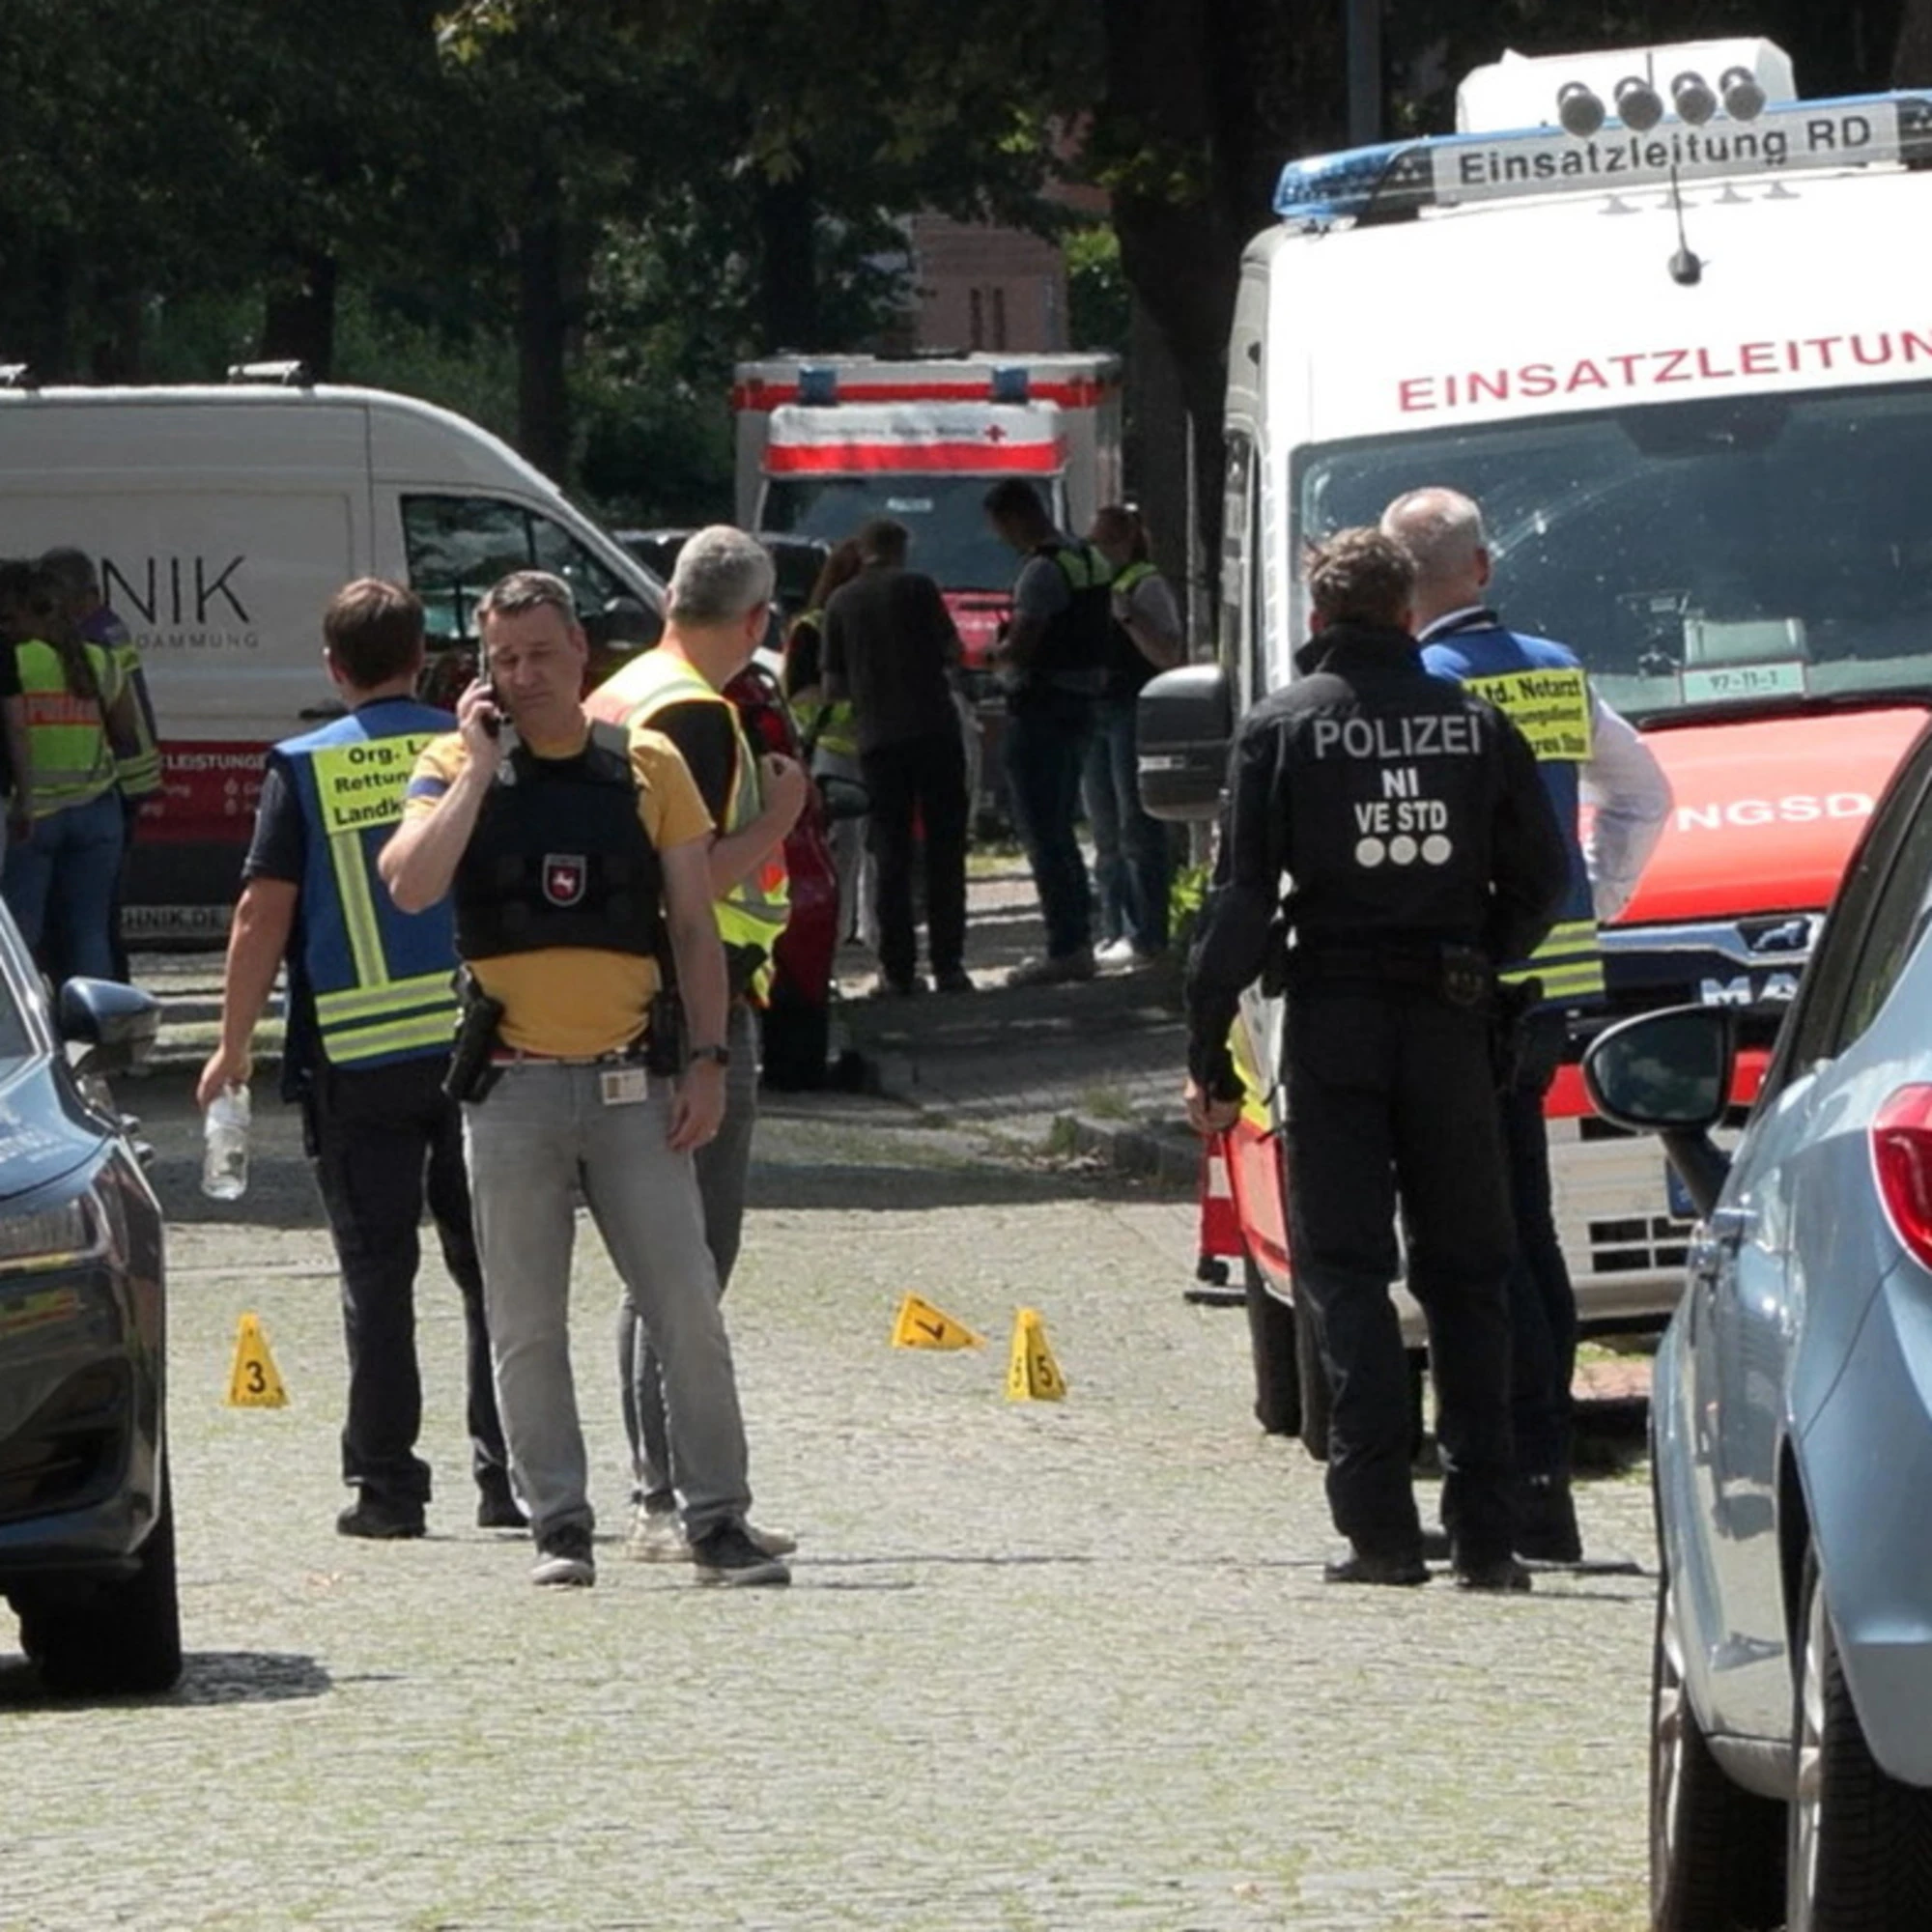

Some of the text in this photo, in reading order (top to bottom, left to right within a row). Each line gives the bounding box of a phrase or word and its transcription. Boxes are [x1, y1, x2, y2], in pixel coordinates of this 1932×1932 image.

[1460, 115, 1872, 185] Einsatzleitung RD
[1398, 329, 1932, 412] EINSATZLEITUN
[1313, 714, 1481, 759] POLIZEI
[349, 747, 401, 765] Org.
[1381, 767, 1419, 799] NI
[1354, 799, 1448, 835] VE STD
[1677, 792, 1873, 832] NGSD
[245, 1360, 266, 1395] 3
[1037, 1355, 1054, 1388] 5
